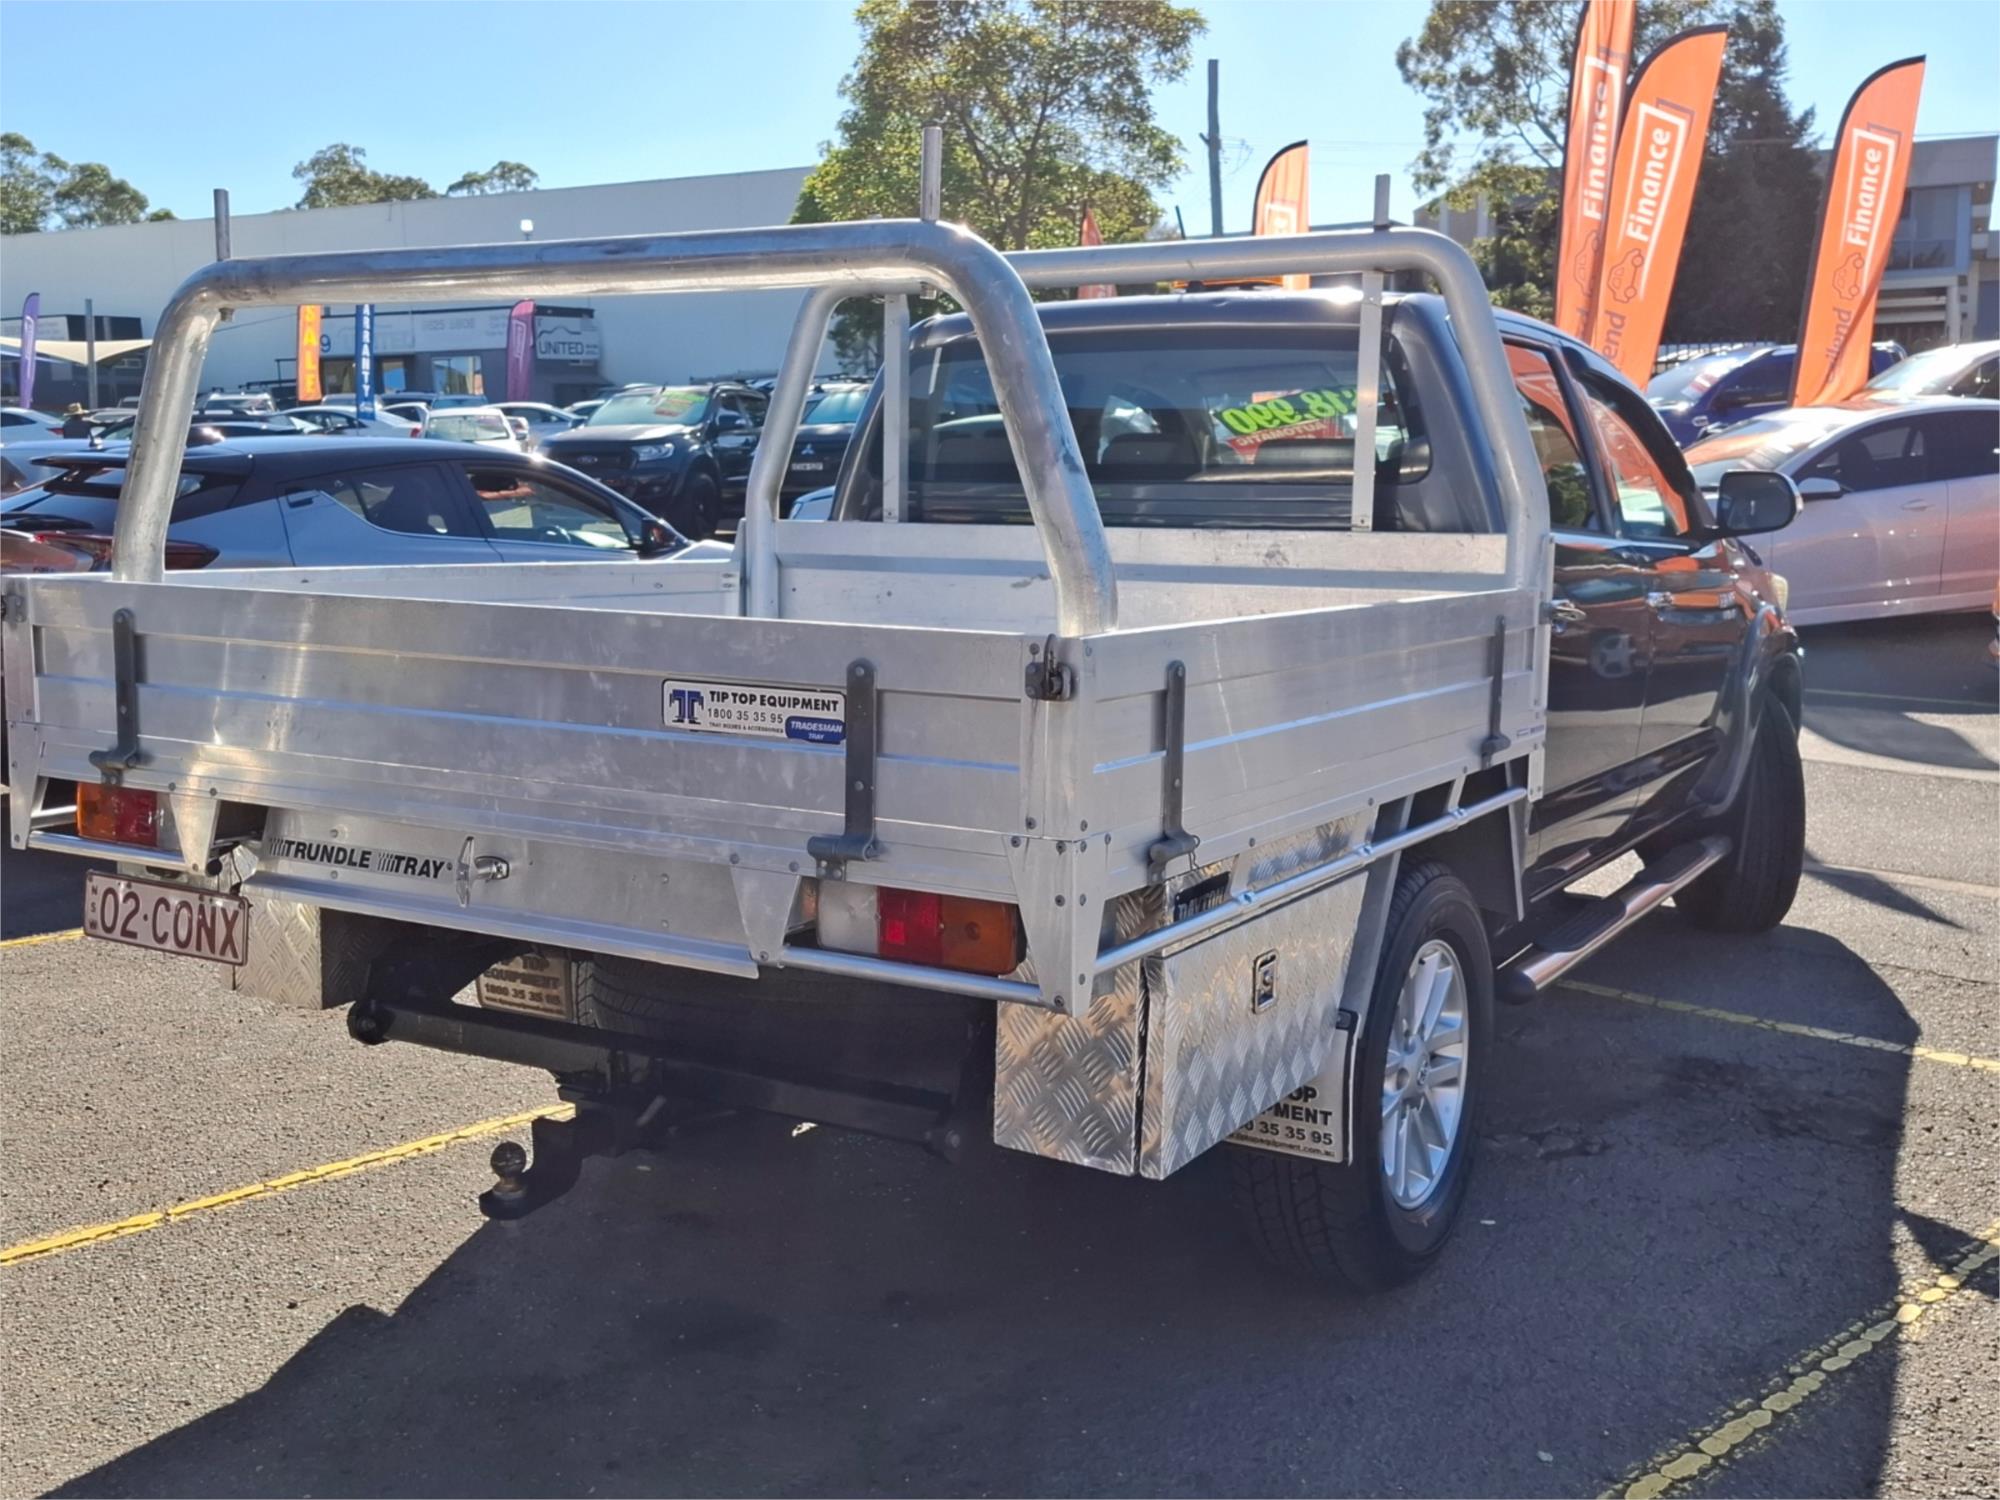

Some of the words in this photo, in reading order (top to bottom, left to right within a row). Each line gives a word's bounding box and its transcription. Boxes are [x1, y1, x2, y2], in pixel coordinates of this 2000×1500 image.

[1583, 81, 1609, 221] Finance
[1626, 127, 1671, 242] Finance
[1846, 147, 1882, 247] Finance
[1602, 310, 1626, 360] end
[303, 304, 318, 394] SALE
[361, 303, 371, 398] ARRANTY
[538, 340, 584, 356] UNITED
[709, 690, 728, 703] TIP
[731, 692, 757, 706] TOP
[760, 695, 839, 712] EQUIPMENT
[707, 708, 732, 720] 1800
[736, 711, 750, 721] 35
[753, 712, 767, 722] 35
[770, 714, 784, 724] 95
[791, 721, 843, 733] TRADESMAN
[808, 732, 824, 740] TRAY
[284, 840, 372, 868] TRUNDLE
[1288, 1085, 1317, 1102] OP
[1272, 1102, 1332, 1126] MENT
[1260, 1121, 1280, 1136] 35
[1285, 1126, 1306, 1141] 35
[1311, 1131, 1333, 1146] 95
